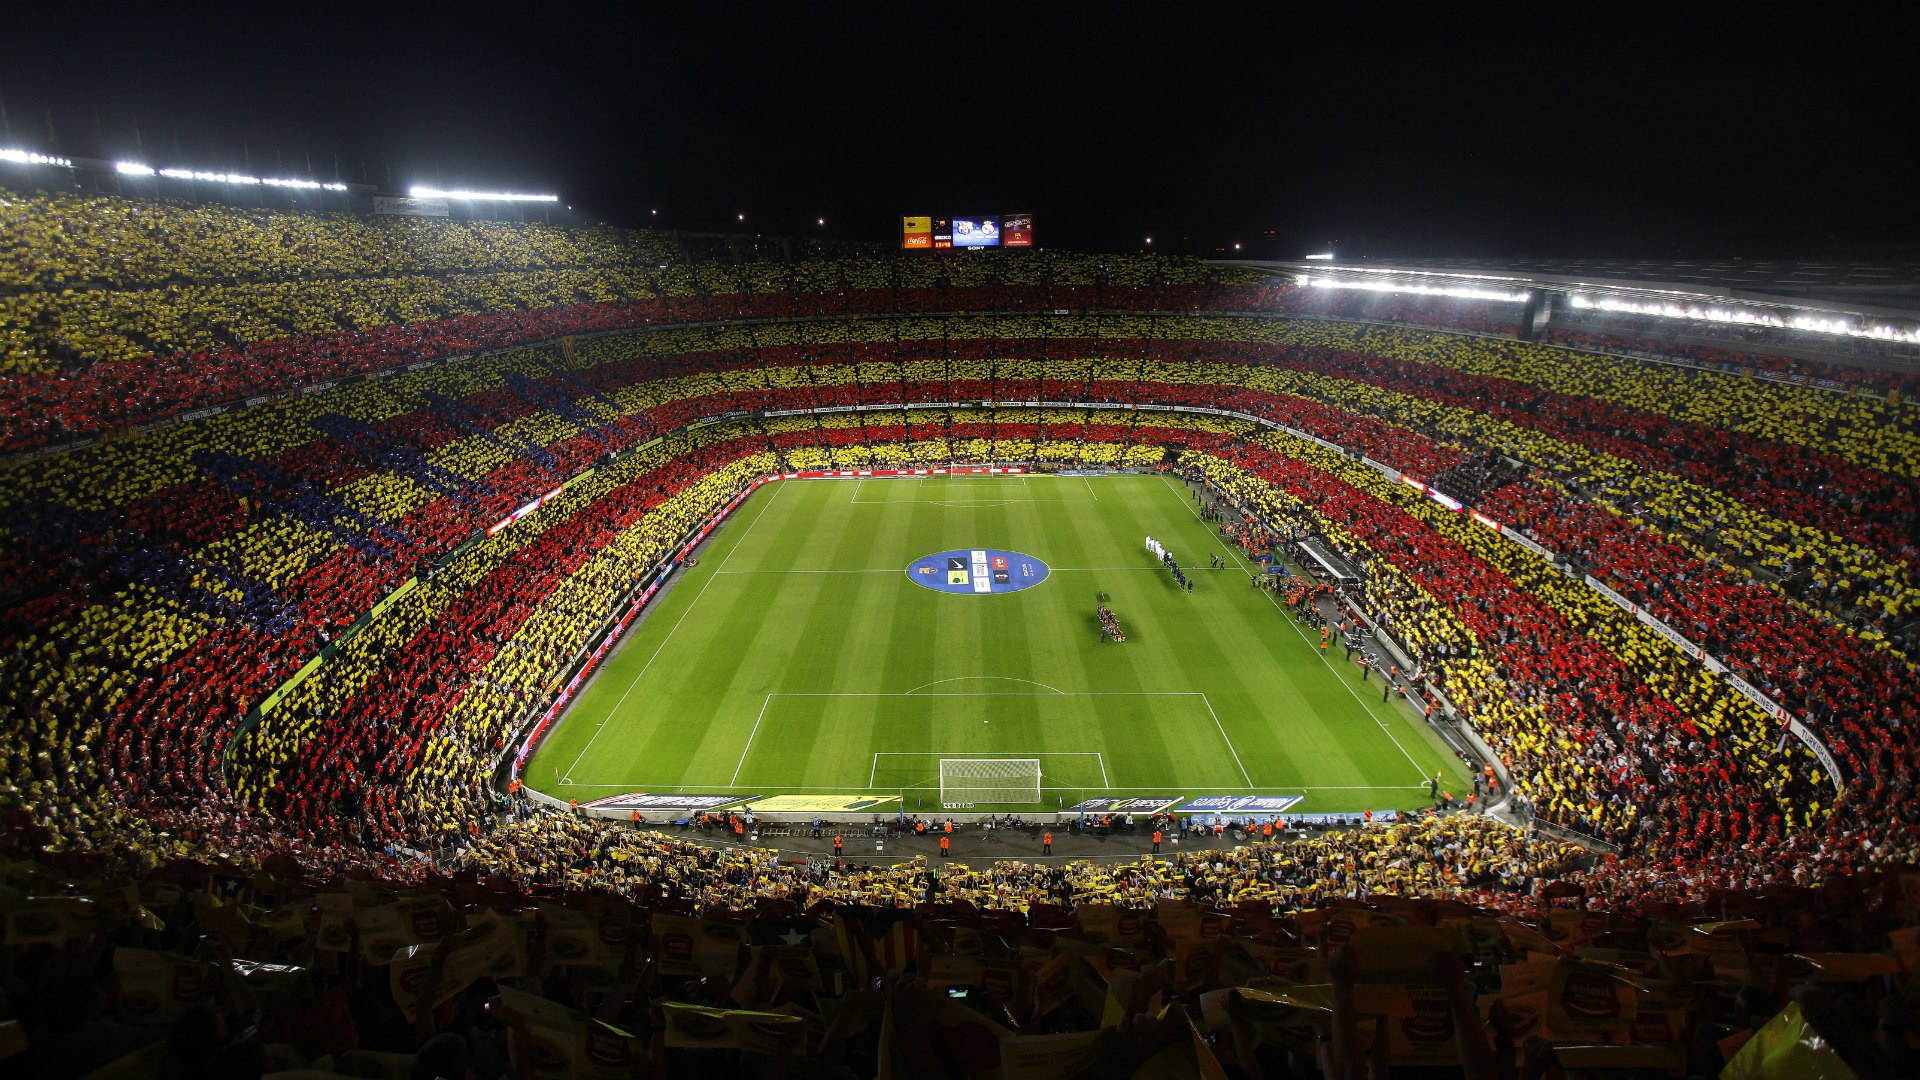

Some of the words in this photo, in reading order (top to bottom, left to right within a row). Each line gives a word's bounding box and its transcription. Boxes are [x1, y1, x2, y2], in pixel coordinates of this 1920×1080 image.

[907, 236, 928, 246] Coca-Cola
[1649, 617, 1672, 640] TURKISH
[1670, 632, 1696, 655] AIRLINES
[1718, 666, 1745, 691] TKISH
[1745, 684, 1774, 712] AIRLINES
